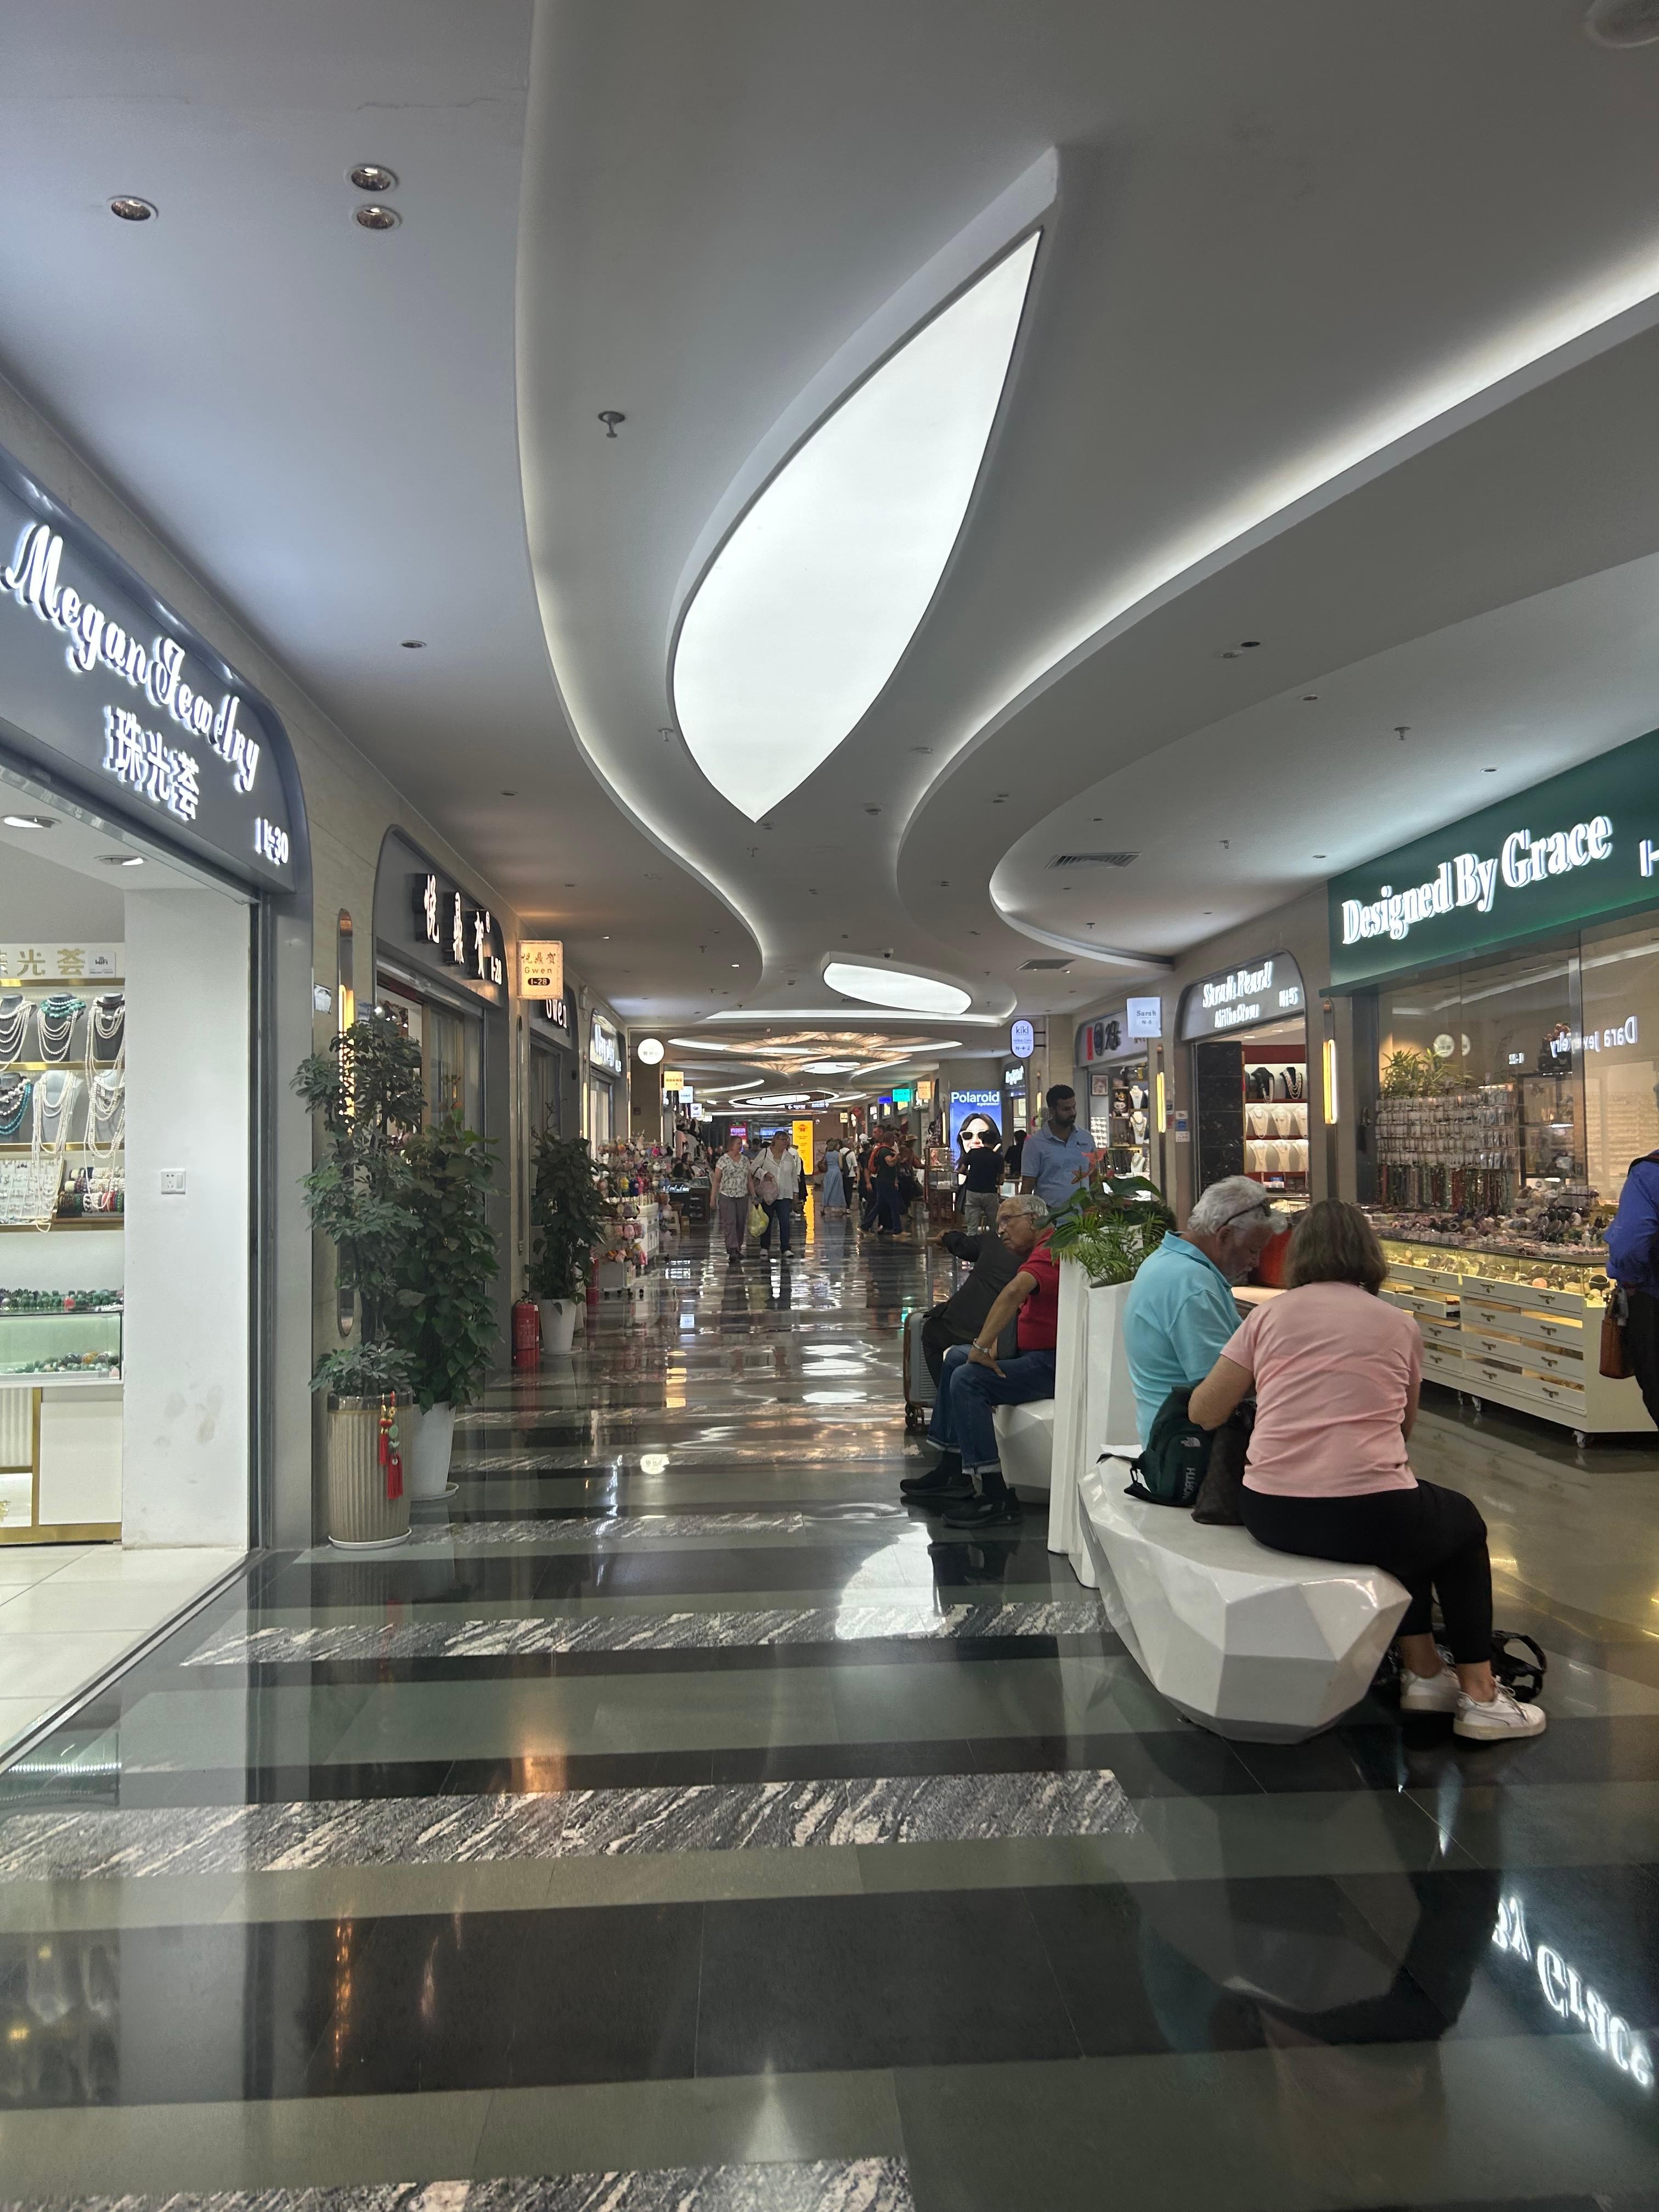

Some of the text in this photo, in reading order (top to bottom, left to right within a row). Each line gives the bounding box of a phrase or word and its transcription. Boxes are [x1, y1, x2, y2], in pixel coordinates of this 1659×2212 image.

[0, 522, 147, 685] Megan
[103, 704, 199, 821] 珠光荟
[1342, 860, 1455, 945] Designed
[1454, 853, 1498, 912] By
[1502, 815, 1613, 888] Grace
[951, 1092, 1000, 1103] Polaroid
